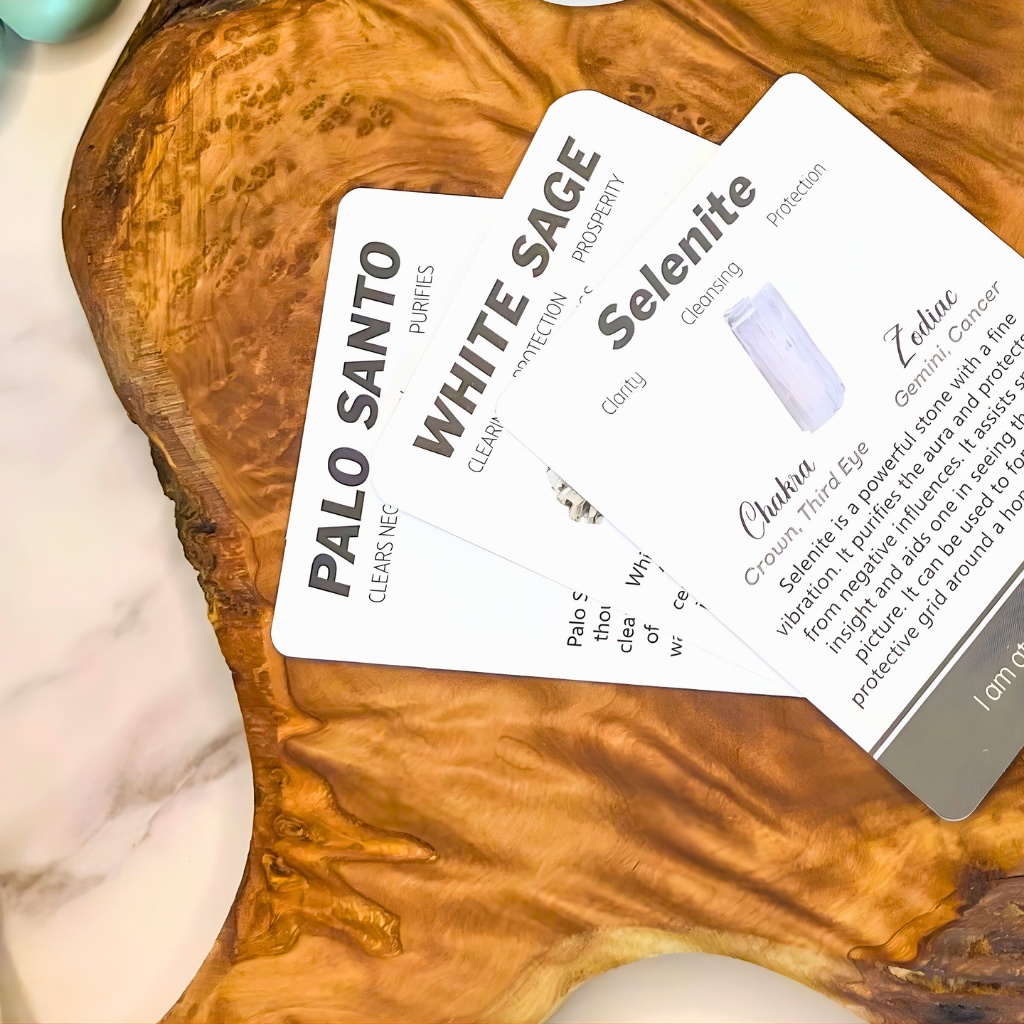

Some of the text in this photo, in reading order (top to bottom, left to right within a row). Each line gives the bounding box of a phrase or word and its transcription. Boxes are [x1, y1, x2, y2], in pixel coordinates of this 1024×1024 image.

[571, 172, 625, 264] PROSPERITY
[765, 163, 827, 228] Protection
[408, 265, 435, 334] PURIFIES
[412, 134, 602, 459] WHITE SAGE
[597, 175, 756, 351] Selenite
[680, 261, 744, 325] Cleansing
[882, 289, 958, 370] Zodiac
[894, 280, 1000, 408] Gemini, Cancer
[307, 241, 401, 598] PALO SANTO
[601, 371, 648, 415] Clarity
[738, 459, 816, 540] Chakra
[779, 313, 1017, 594] Selenite is a powerful stone with a fine
[744, 441, 869, 586] Crown, Third Eye
[776, 567, 842, 636] vibration.
[835, 547, 855, 564] It
[851, 490, 902, 552] purifies
[897, 463, 925, 490] the
[923, 427, 955, 463] aura
[952, 392, 981, 427] and
[803, 602, 842, 643] from
[839, 534, 898, 603] negative
[891, 456, 965, 535] influences.
[957, 438, 977, 454] It
[973, 389, 1017, 440] assists
[825, 597, 878, 655] insight
[874, 563, 904, 599] and
[901, 532, 932, 567] aids
[930, 500, 958, 532] one
[951, 483, 973, 501] in
[970, 431, 1017, 483] seeing
[368, 541, 394, 604] CLEARS
[851, 627, 920, 710] protective
[918, 588, 948, 630] grid
[945, 531, 995, 592] around
[992, 522, 1006, 535] a
[854, 606, 908, 666] picture.
[900, 586, 920, 603] It
[917, 557, 944, 587] can
[937, 534, 963, 558] be
[959, 491, 995, 534] used
[990, 476, 1010, 495] to
[566, 607, 586, 647] Palo
[643, 623, 660, 644] of
[973, 695, 990, 712] I
[985, 667, 1017, 701] am
